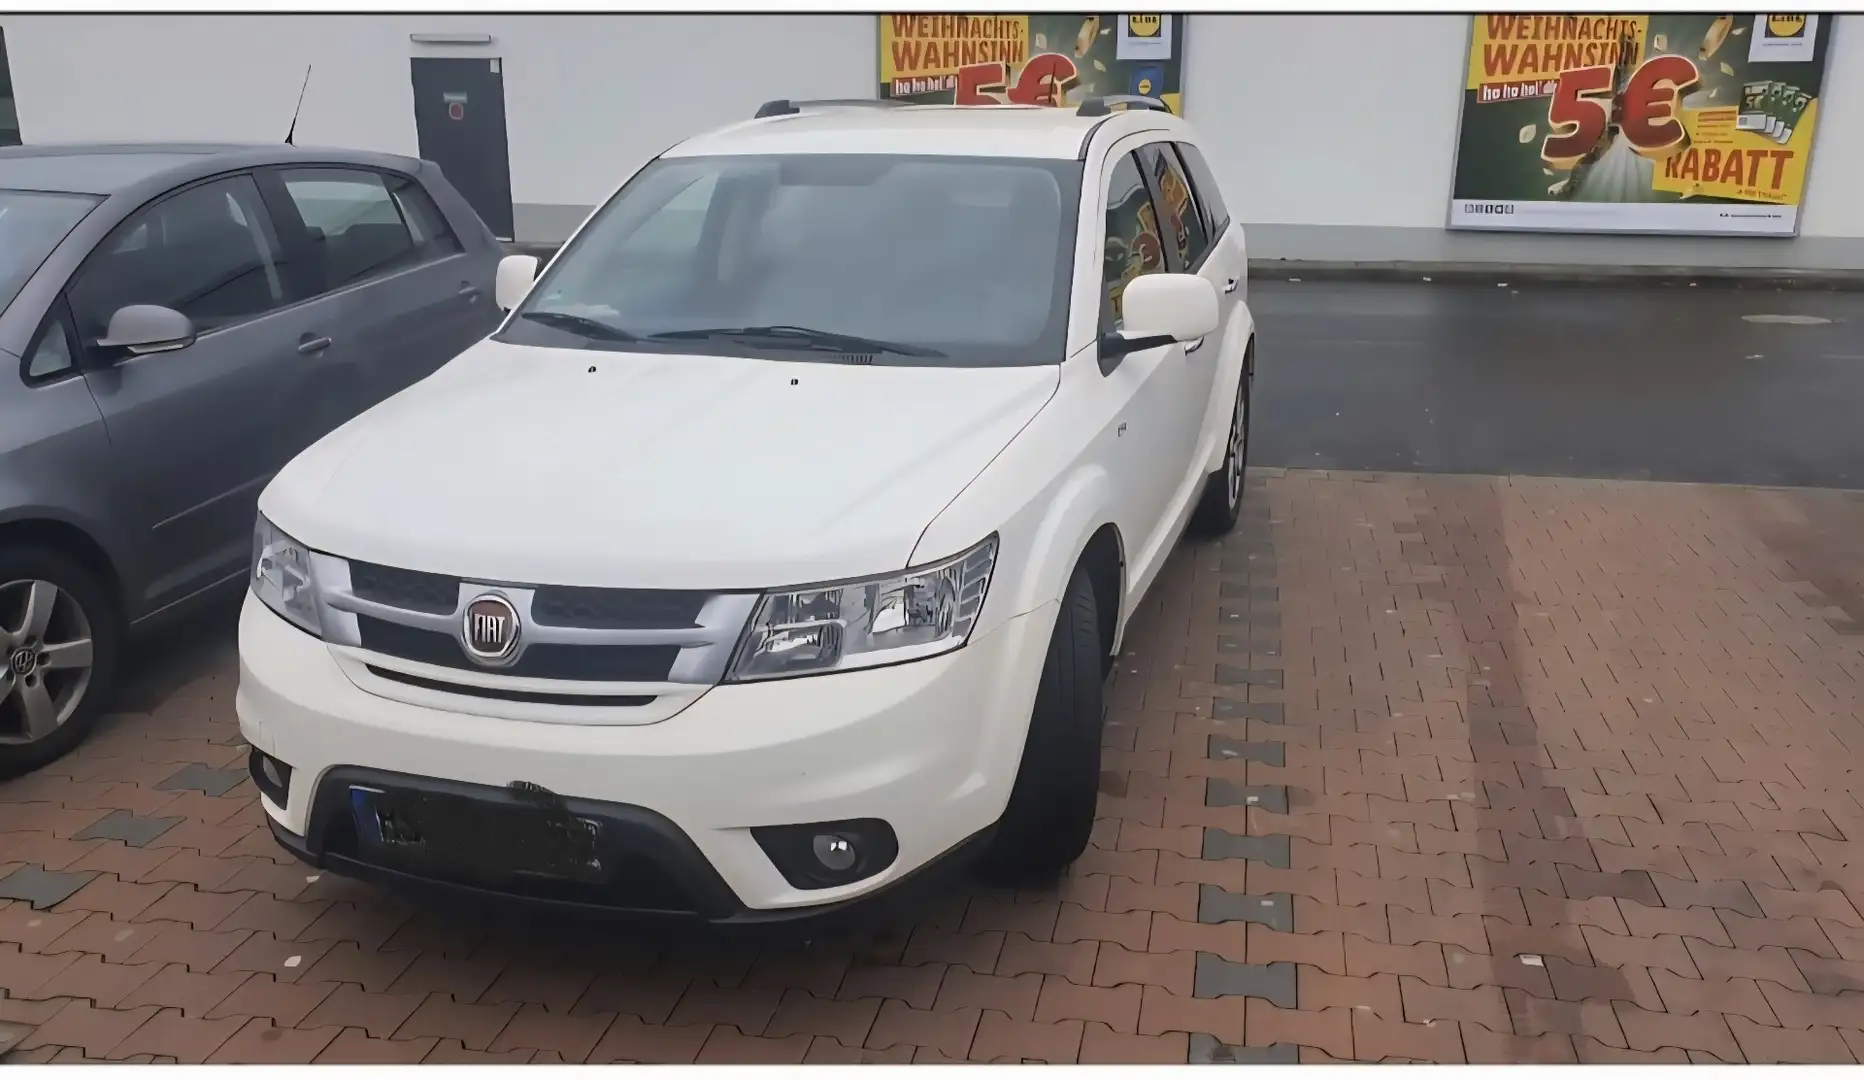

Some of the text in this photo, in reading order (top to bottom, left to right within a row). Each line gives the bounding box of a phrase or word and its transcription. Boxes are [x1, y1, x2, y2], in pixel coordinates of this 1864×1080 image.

[1487, 14, 1642, 41] WEIHNACHTS-
[891, 40, 1023, 72] WAHNSINN
[1483, 42, 1639, 77] WAHNSINN
[1665, 148, 1794, 190] RABATT
[474, 612, 506, 643] FIAT
